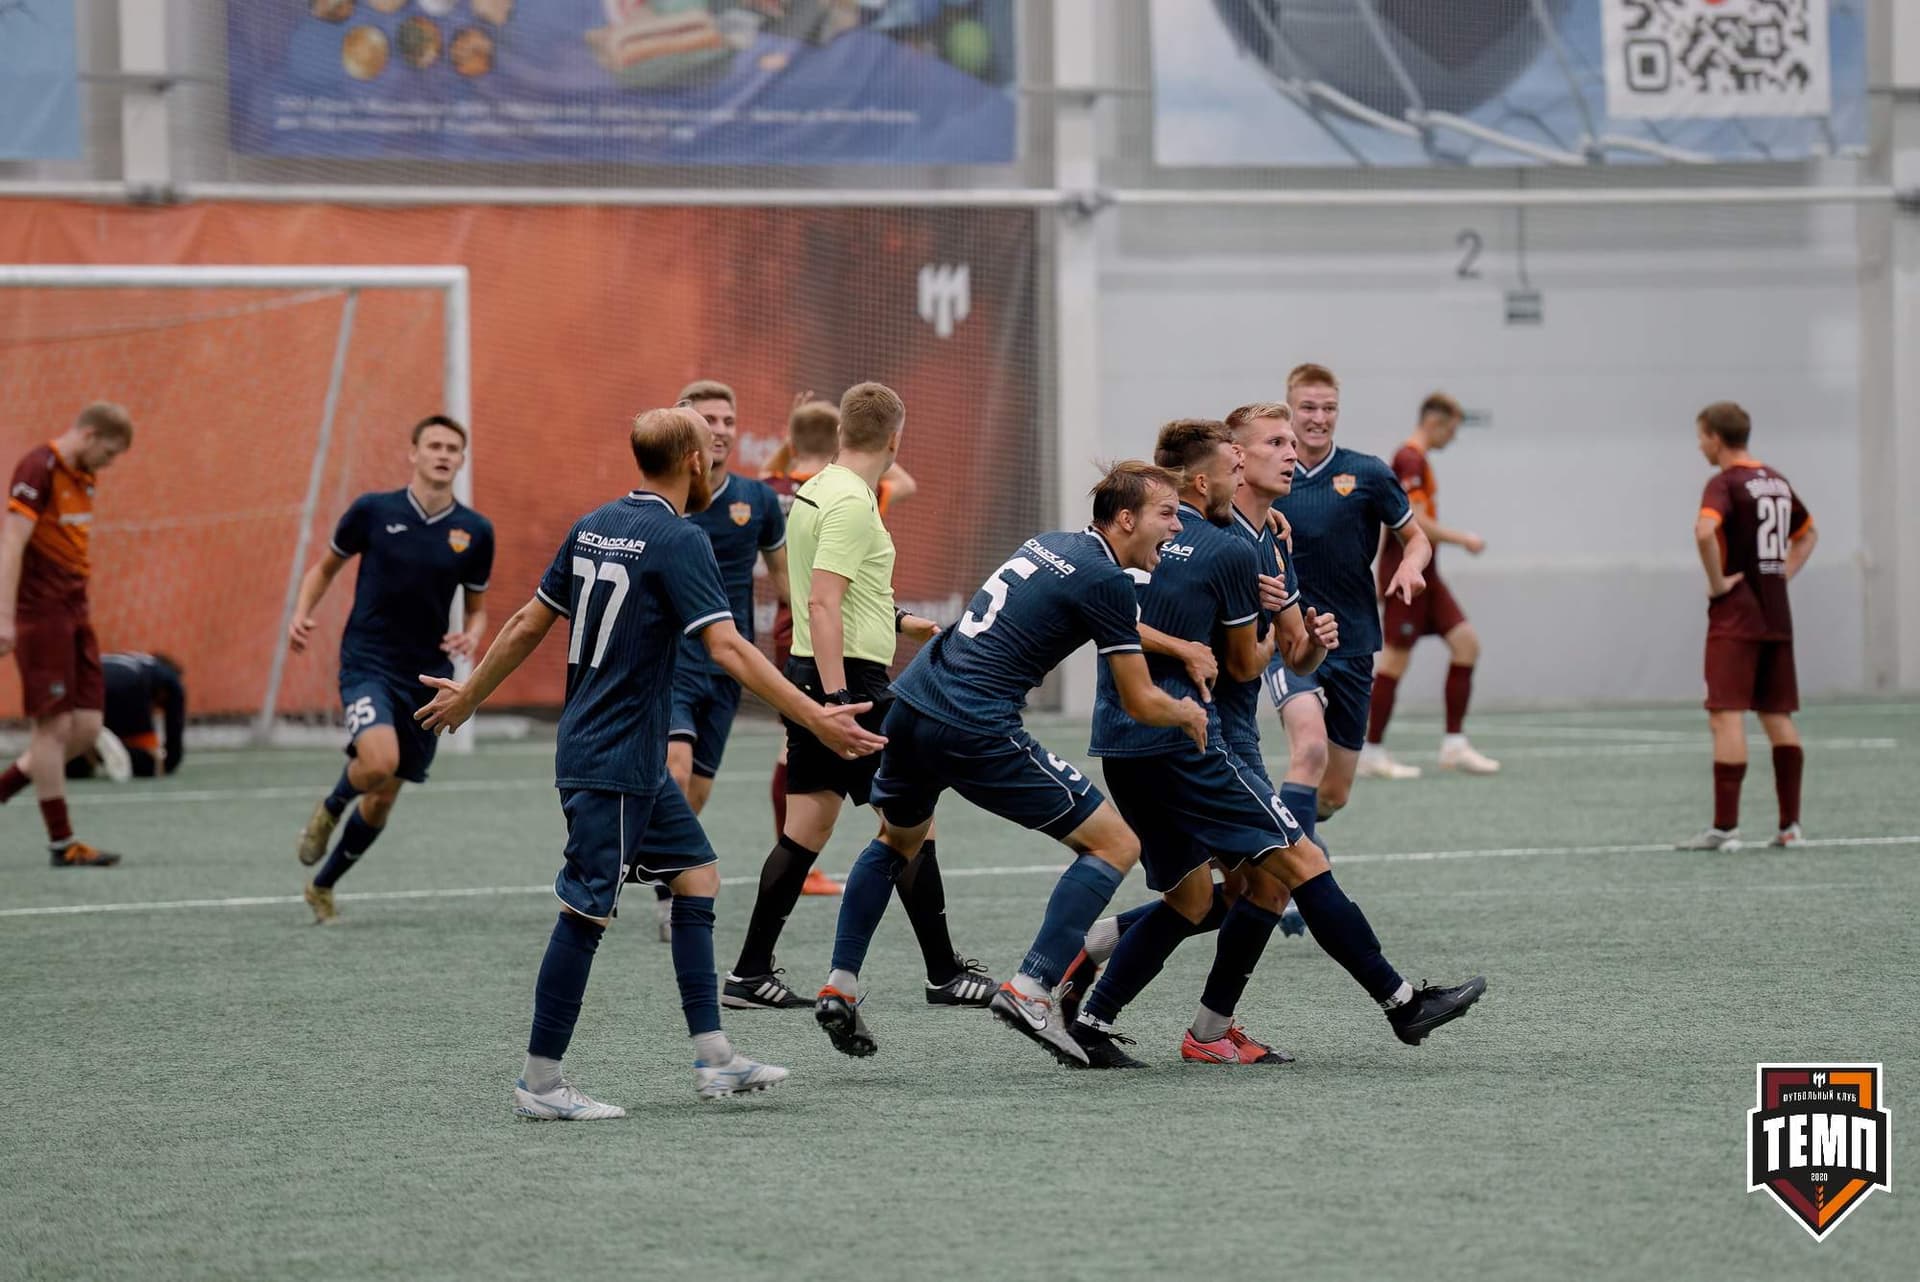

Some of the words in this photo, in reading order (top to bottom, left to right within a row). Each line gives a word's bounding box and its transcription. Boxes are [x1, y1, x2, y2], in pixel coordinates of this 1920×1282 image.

[1455, 228, 1486, 281] 2
[1757, 496, 1793, 561] 20
[568, 556, 630, 669] 77
[958, 556, 1040, 639] 5
[1047, 751, 1083, 782] 5
[1270, 795, 1299, 830] 6
